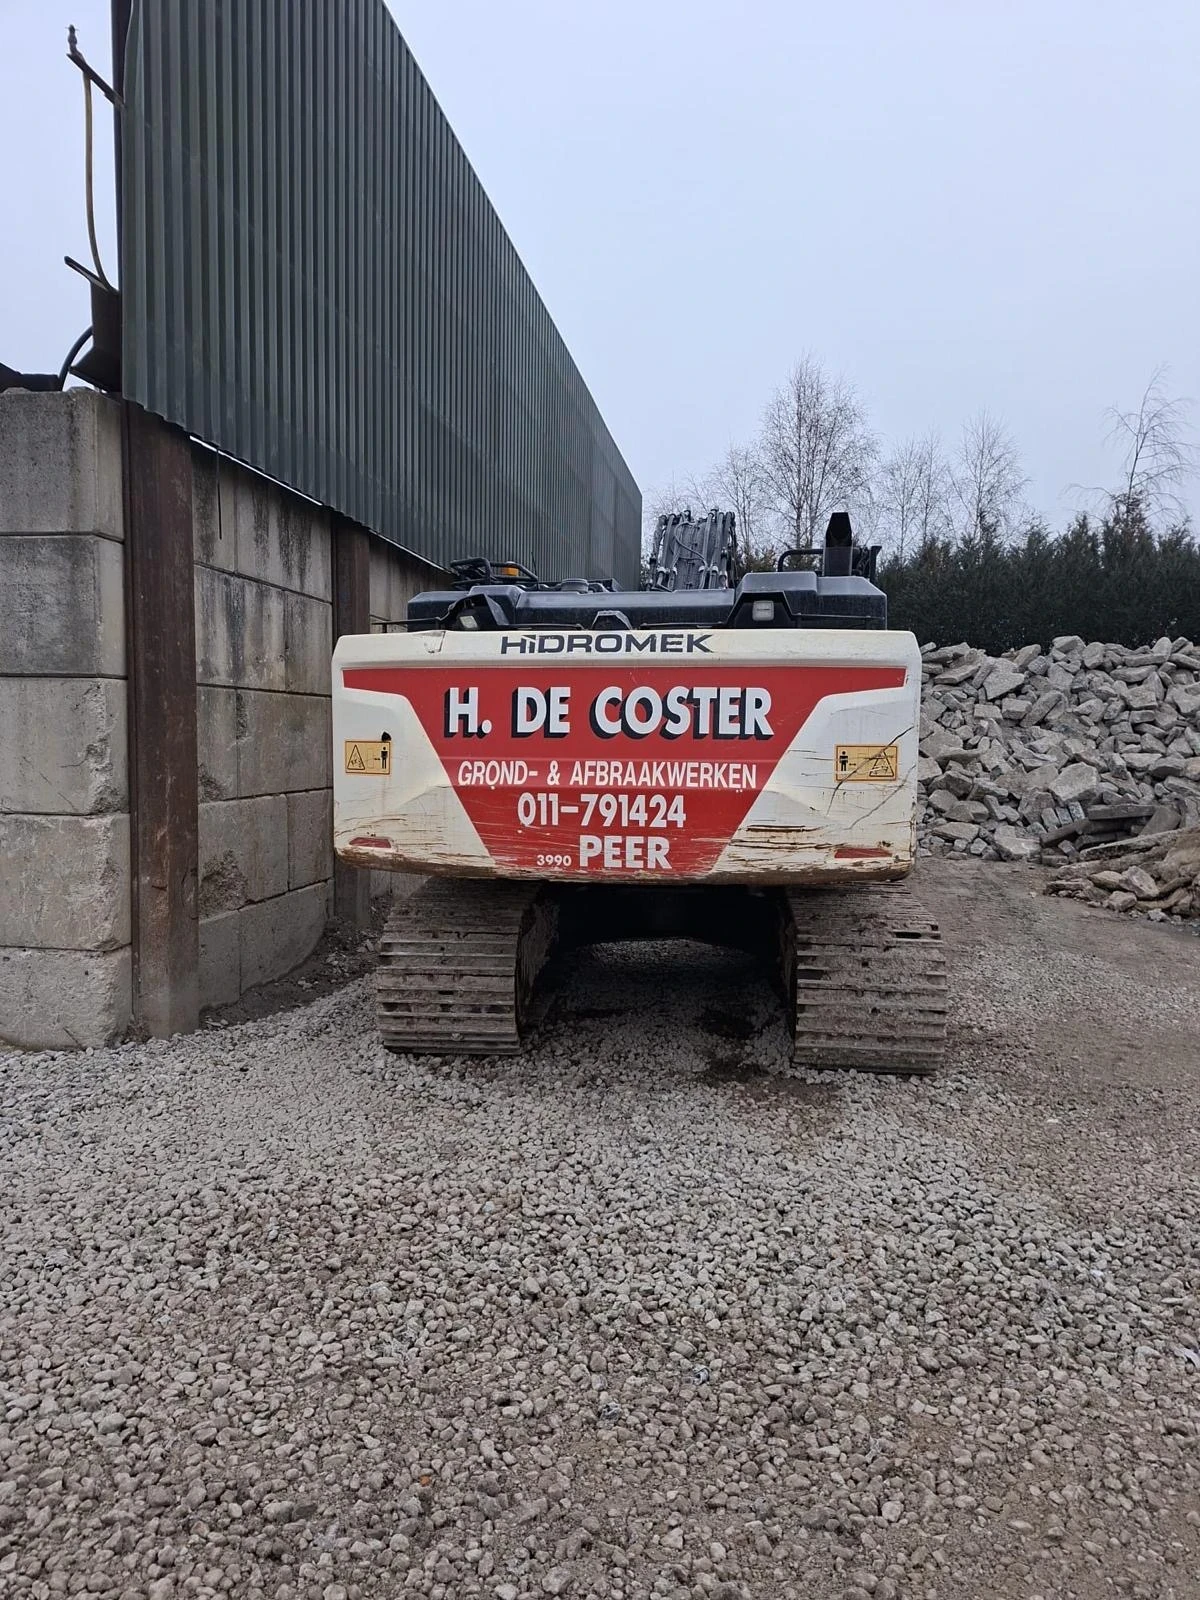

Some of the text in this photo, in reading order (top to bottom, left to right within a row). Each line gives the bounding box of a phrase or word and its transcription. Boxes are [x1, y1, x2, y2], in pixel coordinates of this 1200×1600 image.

[445, 685, 774, 740] H. DE COSTER
[457, 760, 757, 789] GROND- & AFBRAAKWERKEN
[517, 791, 687, 828] 011-791424
[536, 835, 673, 870] 3990 PEER
